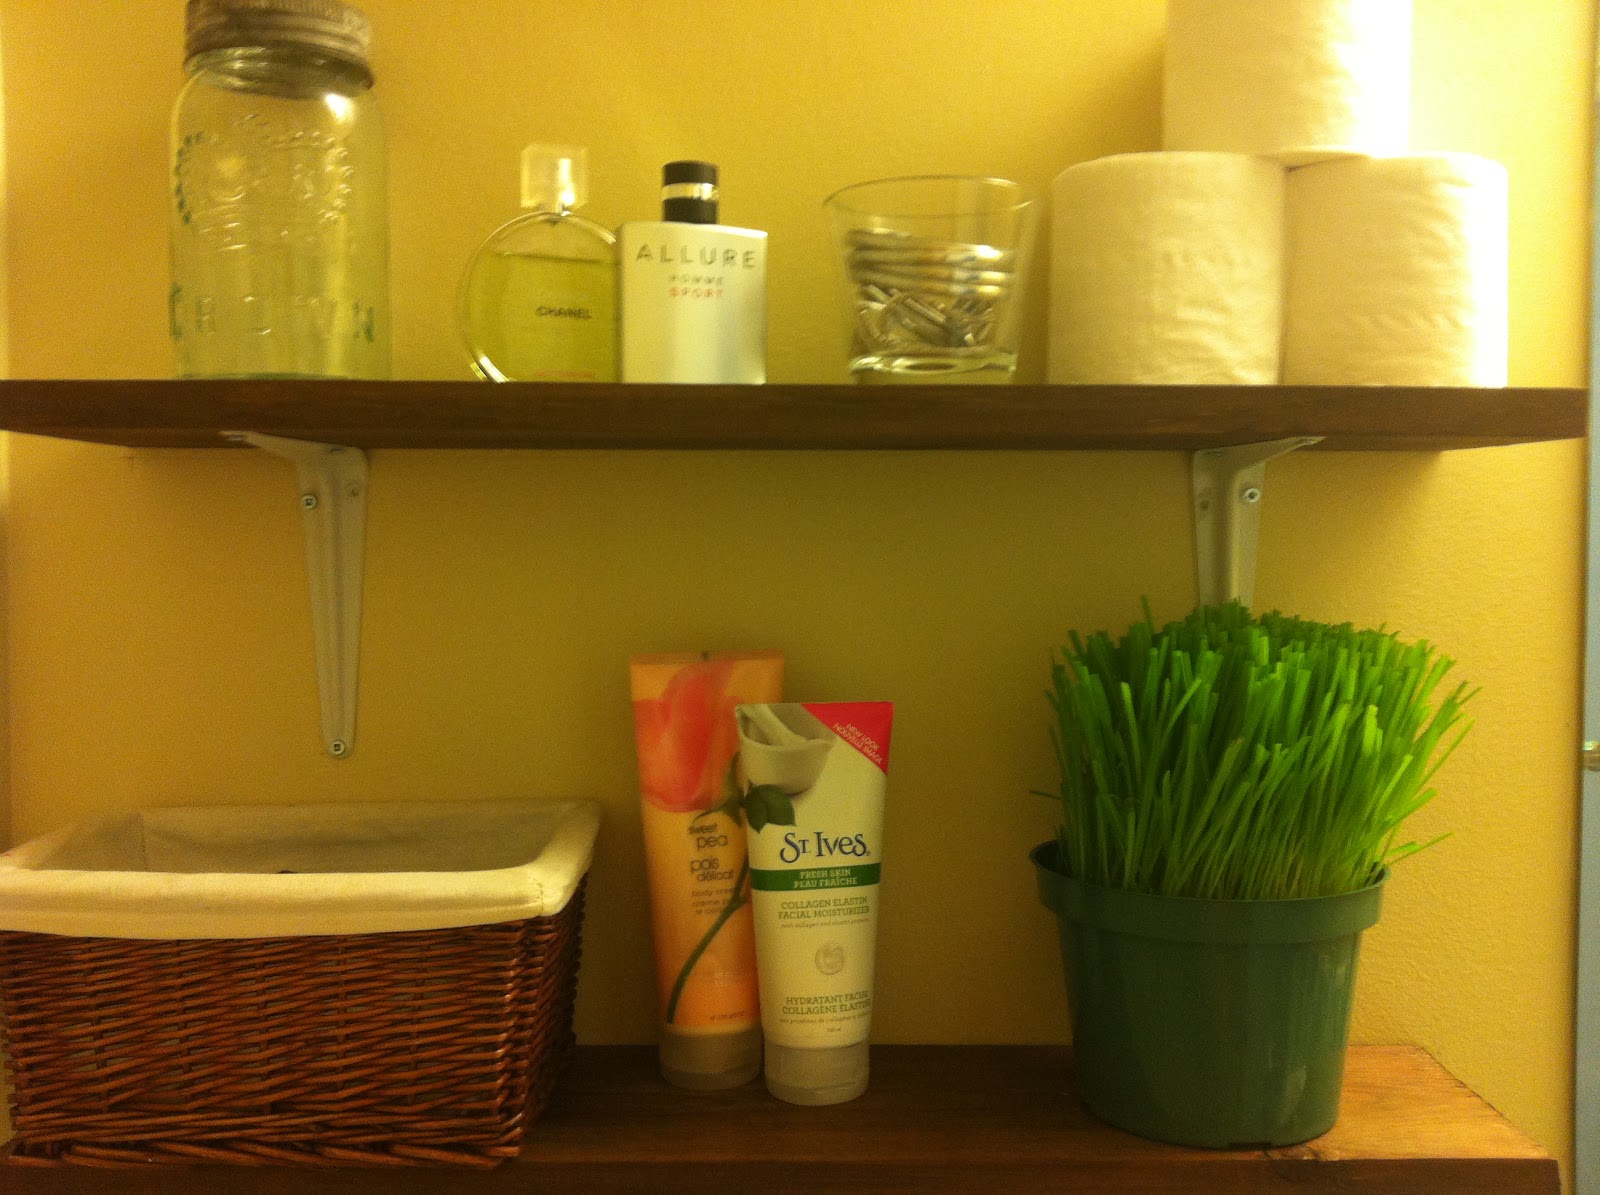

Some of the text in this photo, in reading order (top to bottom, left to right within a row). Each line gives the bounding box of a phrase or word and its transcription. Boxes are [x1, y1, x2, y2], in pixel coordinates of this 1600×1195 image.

[635, 243, 756, 270] ALLURE
[535, 304, 592, 320] CHANEL
[697, 835, 728, 851] pea
[690, 856, 720, 874] pais
[800, 868, 852, 879] FRESH SKIN
[794, 879, 818, 888] PEAU
[781, 896, 868, 910] COLLAGEN ELASTIN
[778, 905, 870, 920] FACIAL MOISTURIZER
[786, 995, 843, 1005] HYDRATANT
